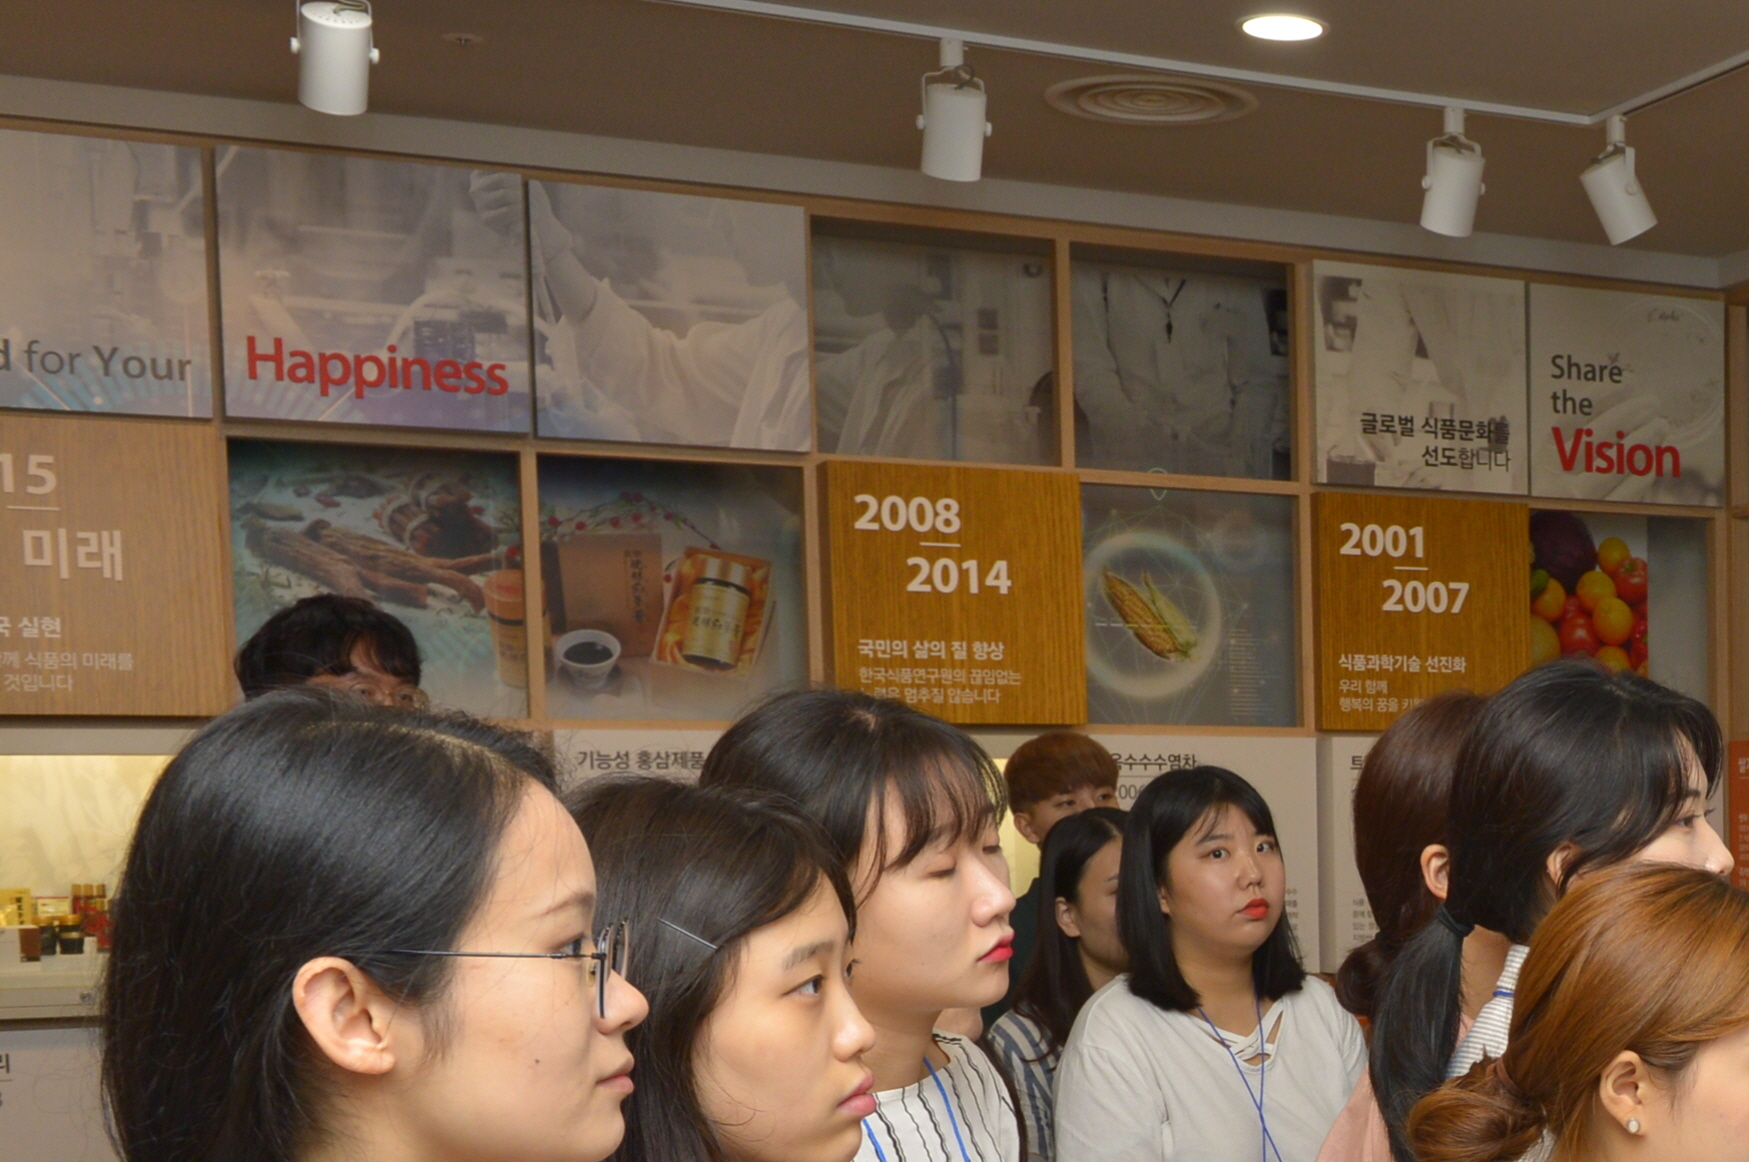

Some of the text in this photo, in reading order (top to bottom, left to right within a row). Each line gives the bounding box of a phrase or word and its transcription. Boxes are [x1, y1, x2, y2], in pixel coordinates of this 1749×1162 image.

[24, 340, 81, 376] for
[93, 346, 191, 381] Your
[247, 336, 509, 398] Happiness
[1551, 355, 1622, 383] Share
[1551, 390, 1592, 416] the
[1361, 413, 1510, 445] 글로벌 식품문화를
[1422, 447, 1510, 472] 선도합니다
[1552, 427, 1680, 478] Vision
[854, 494, 961, 533] 2008
[1340, 523, 1424, 558] 2001
[22, 529, 124, 582] 미래
[906, 557, 1012, 594] 2014
[1382, 579, 1469, 614] 2007
[18, 616, 61, 638] 실현
[25, 652, 134, 671] 식품의 미래를
[858, 639, 1004, 661] 국민의 삶의 질 향상
[1338, 653, 1466, 673] 식품과학기술 선진화
[3, 674, 73, 692] 것입니다
[860, 667, 966, 685] 한국식품연구원의
[1339, 679, 1388, 694] 우리 함께
[860, 687, 1000, 705] 력은 멈추질 않습니다
[1339, 698, 1399, 712] 행복의 꿈을
[577, 751, 705, 770] 기능성 홍삼제품
